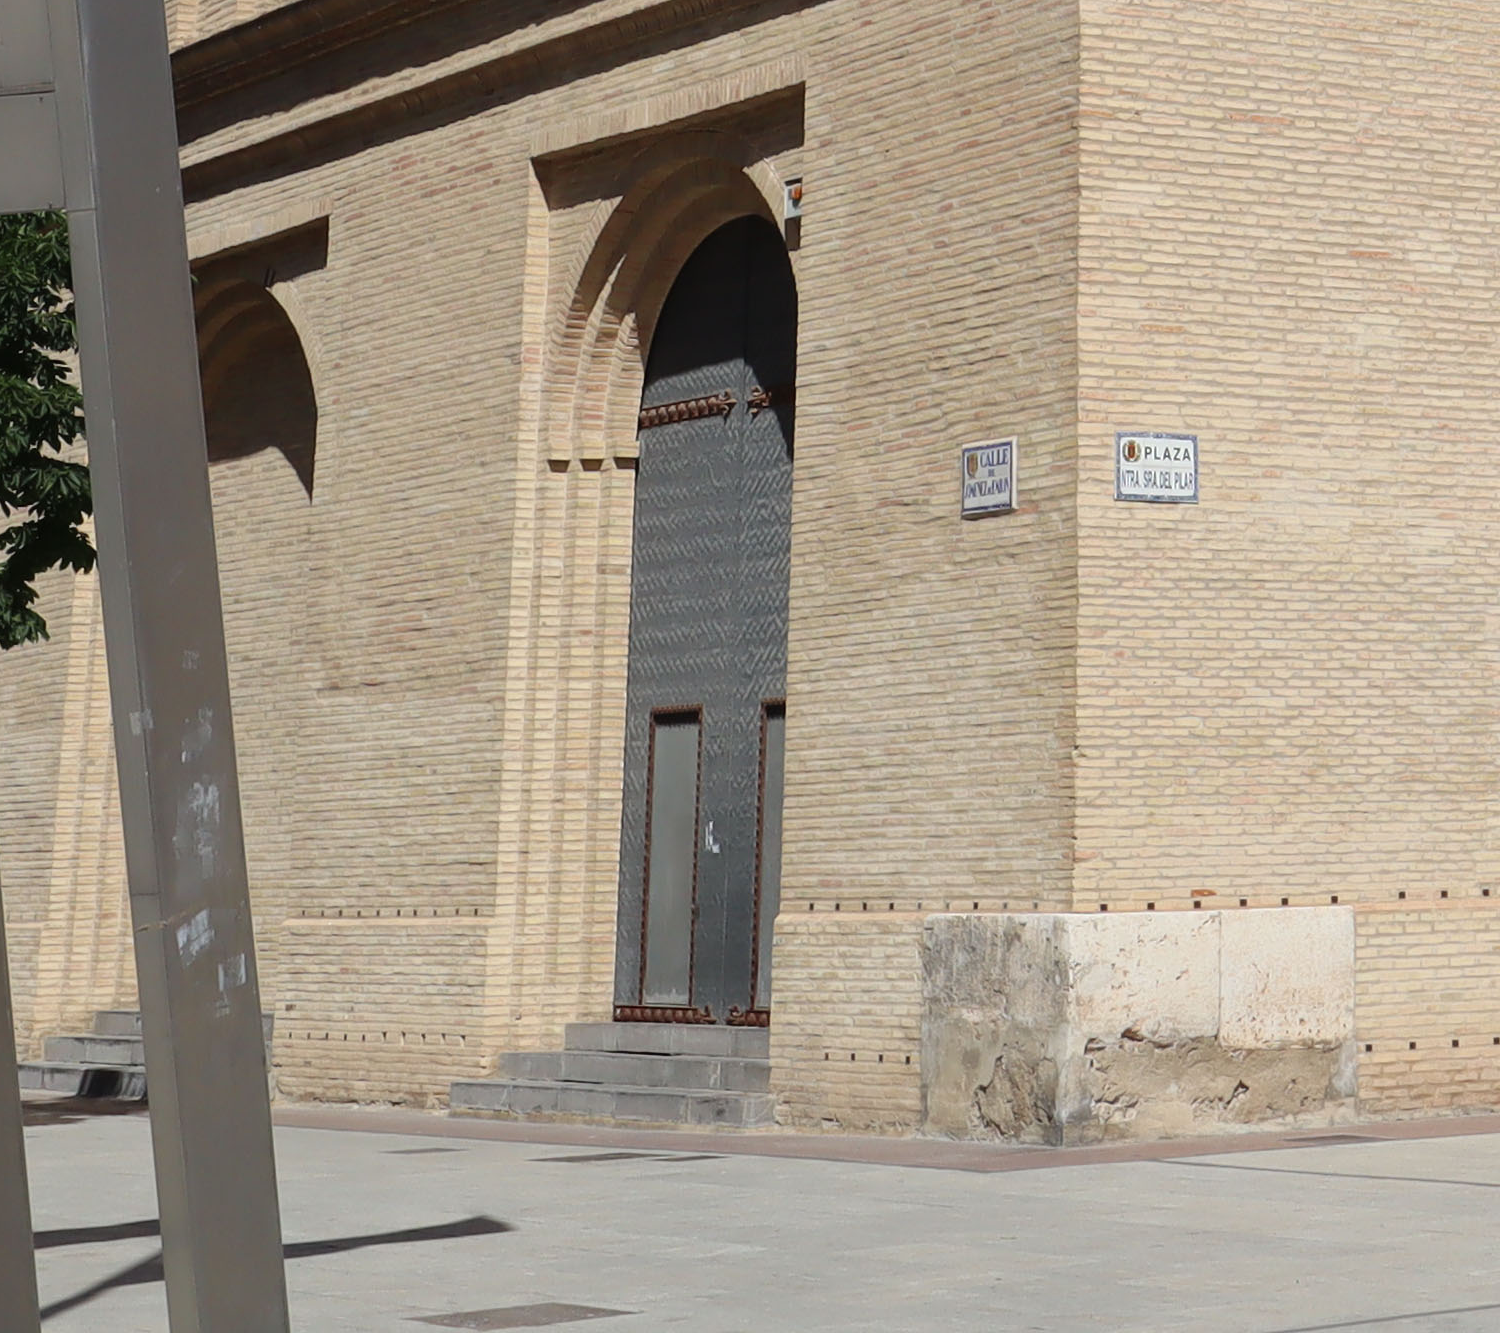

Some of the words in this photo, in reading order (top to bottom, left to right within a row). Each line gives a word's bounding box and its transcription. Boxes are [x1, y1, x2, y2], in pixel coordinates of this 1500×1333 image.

[980, 448, 1009, 468] CALLE
[1144, 446, 1191, 462] PLAZA
[1160, 471, 1172, 489] DEL
[1174, 472, 1194, 490] PILAR
